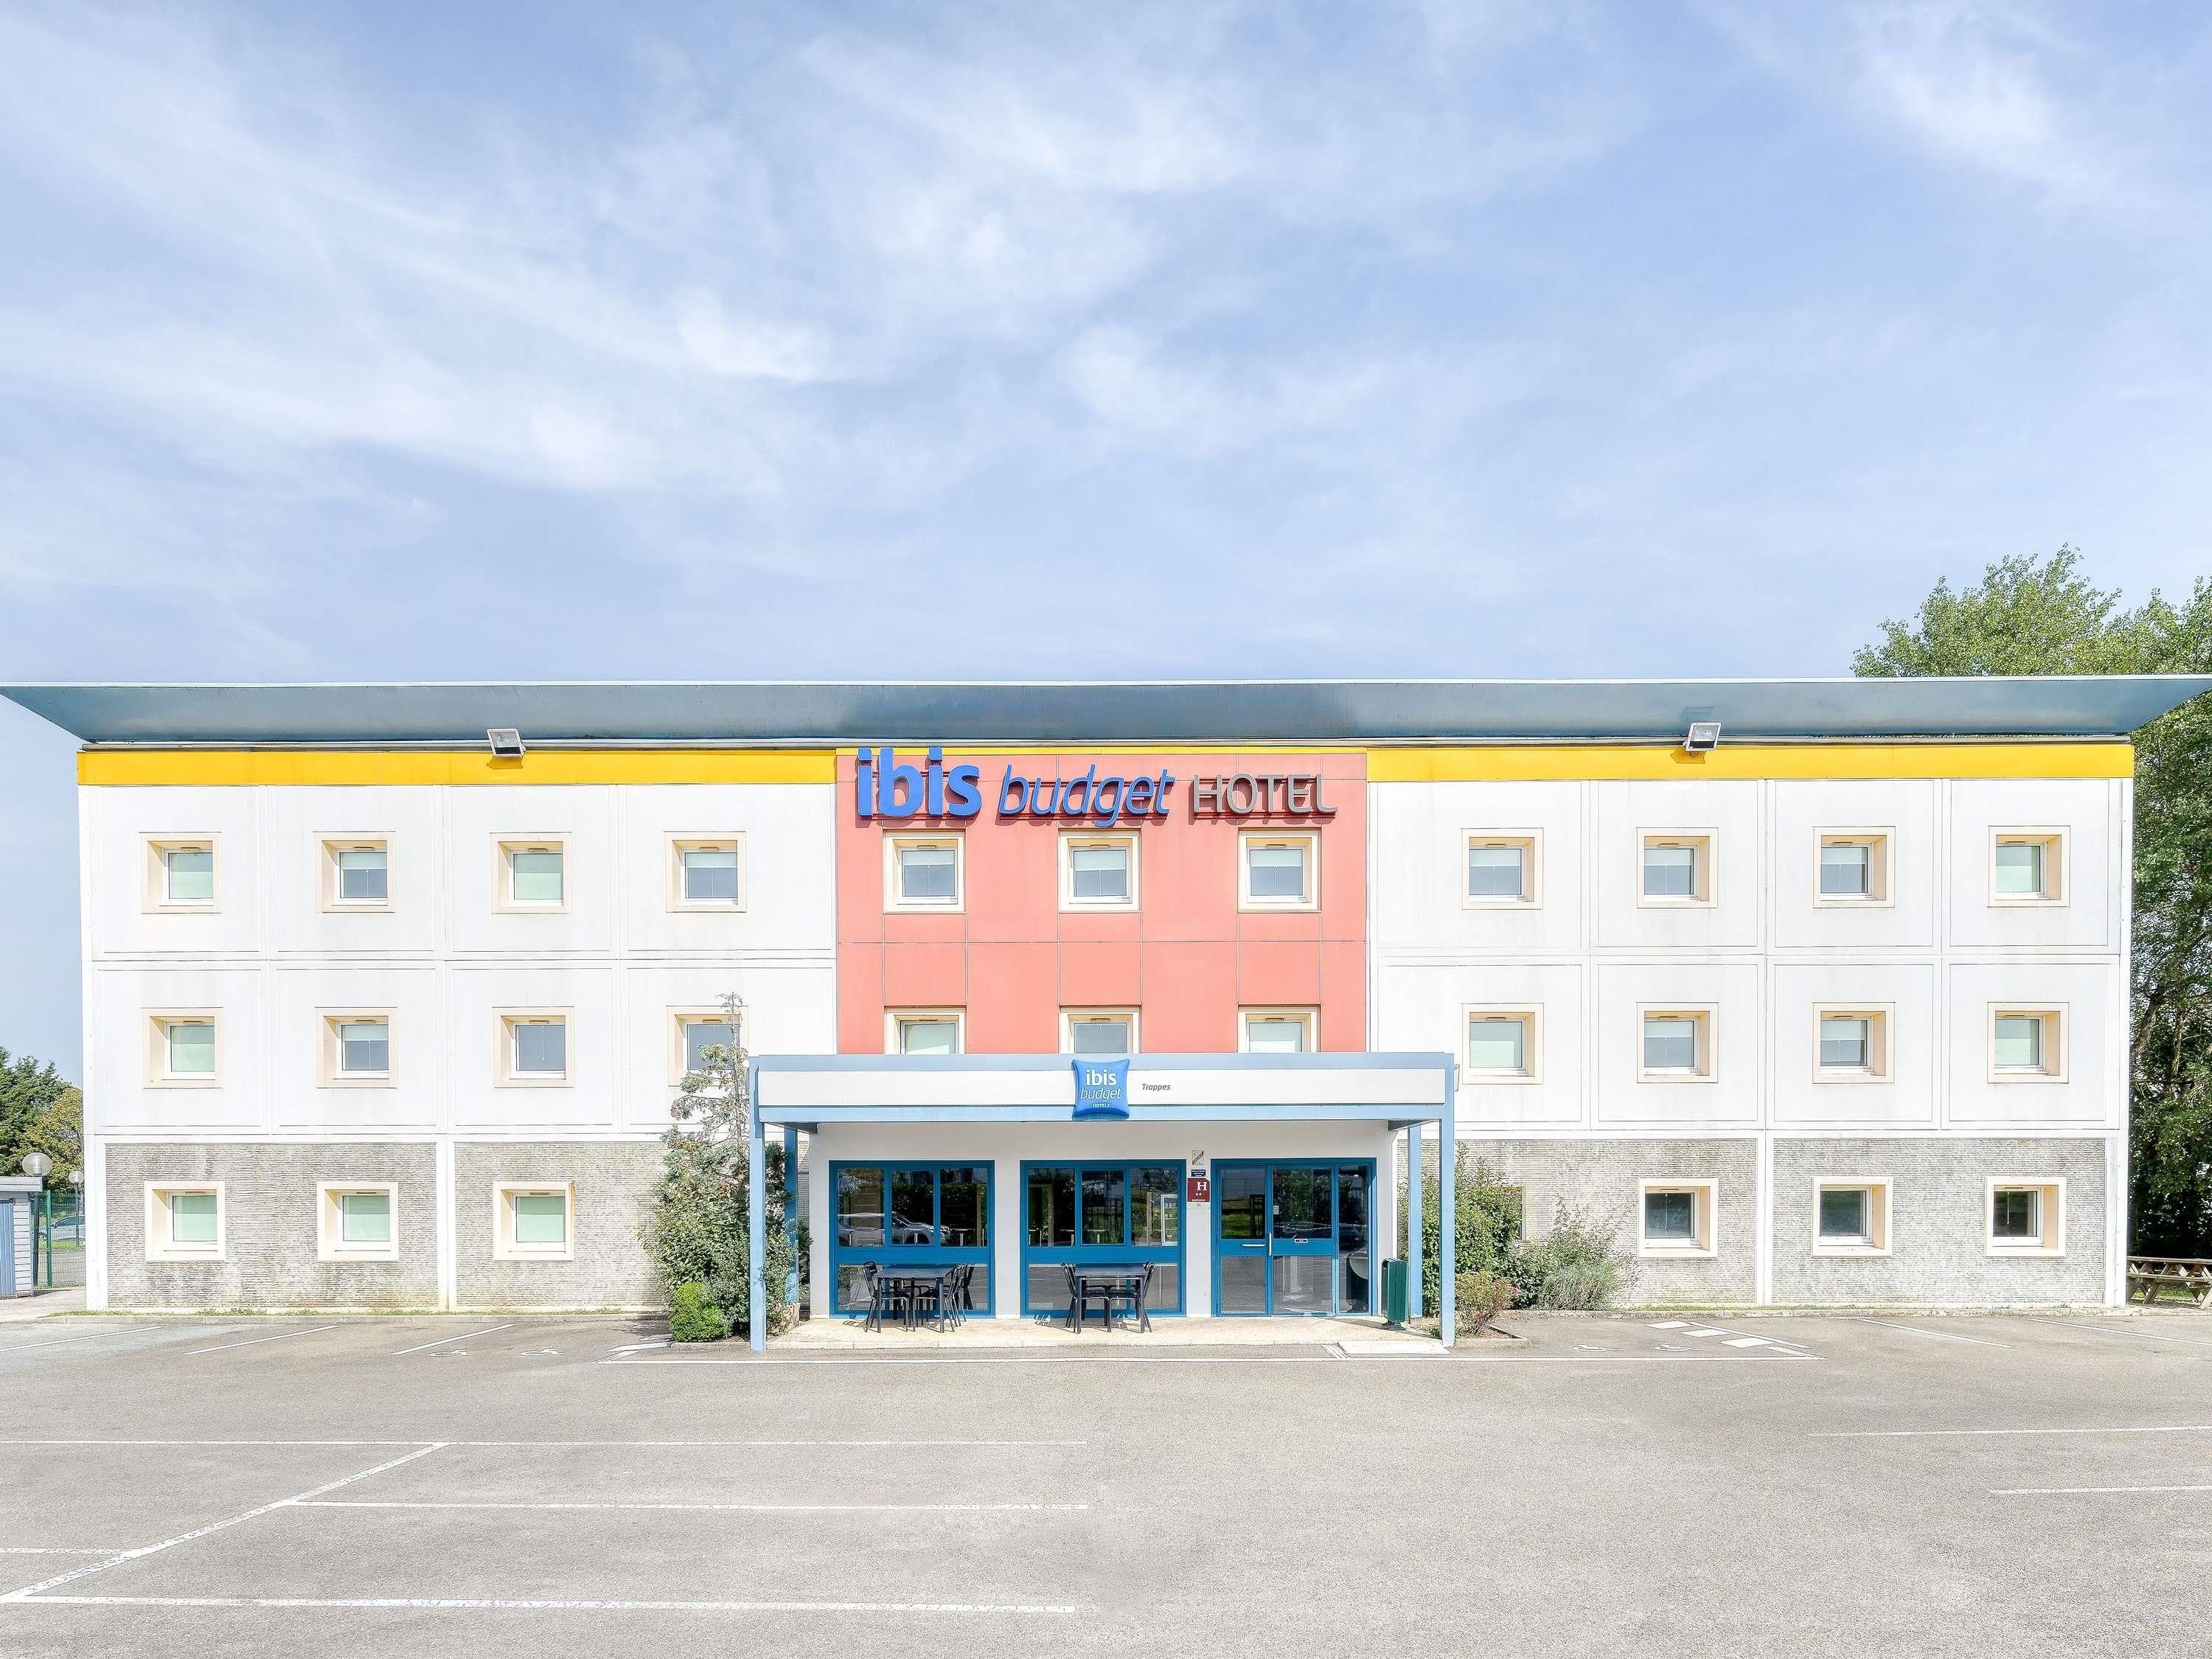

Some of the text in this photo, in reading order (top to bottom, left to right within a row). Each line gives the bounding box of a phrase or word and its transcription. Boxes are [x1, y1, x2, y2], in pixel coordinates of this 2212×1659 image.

[858, 746, 1338, 827] ibis budget HOTEL
[1086, 1068, 1117, 1086] ibis
[1080, 1087, 1121, 1102] budget
[1141, 1083, 1171, 1091] Trappes
[1197, 1181, 1208, 1192] H
